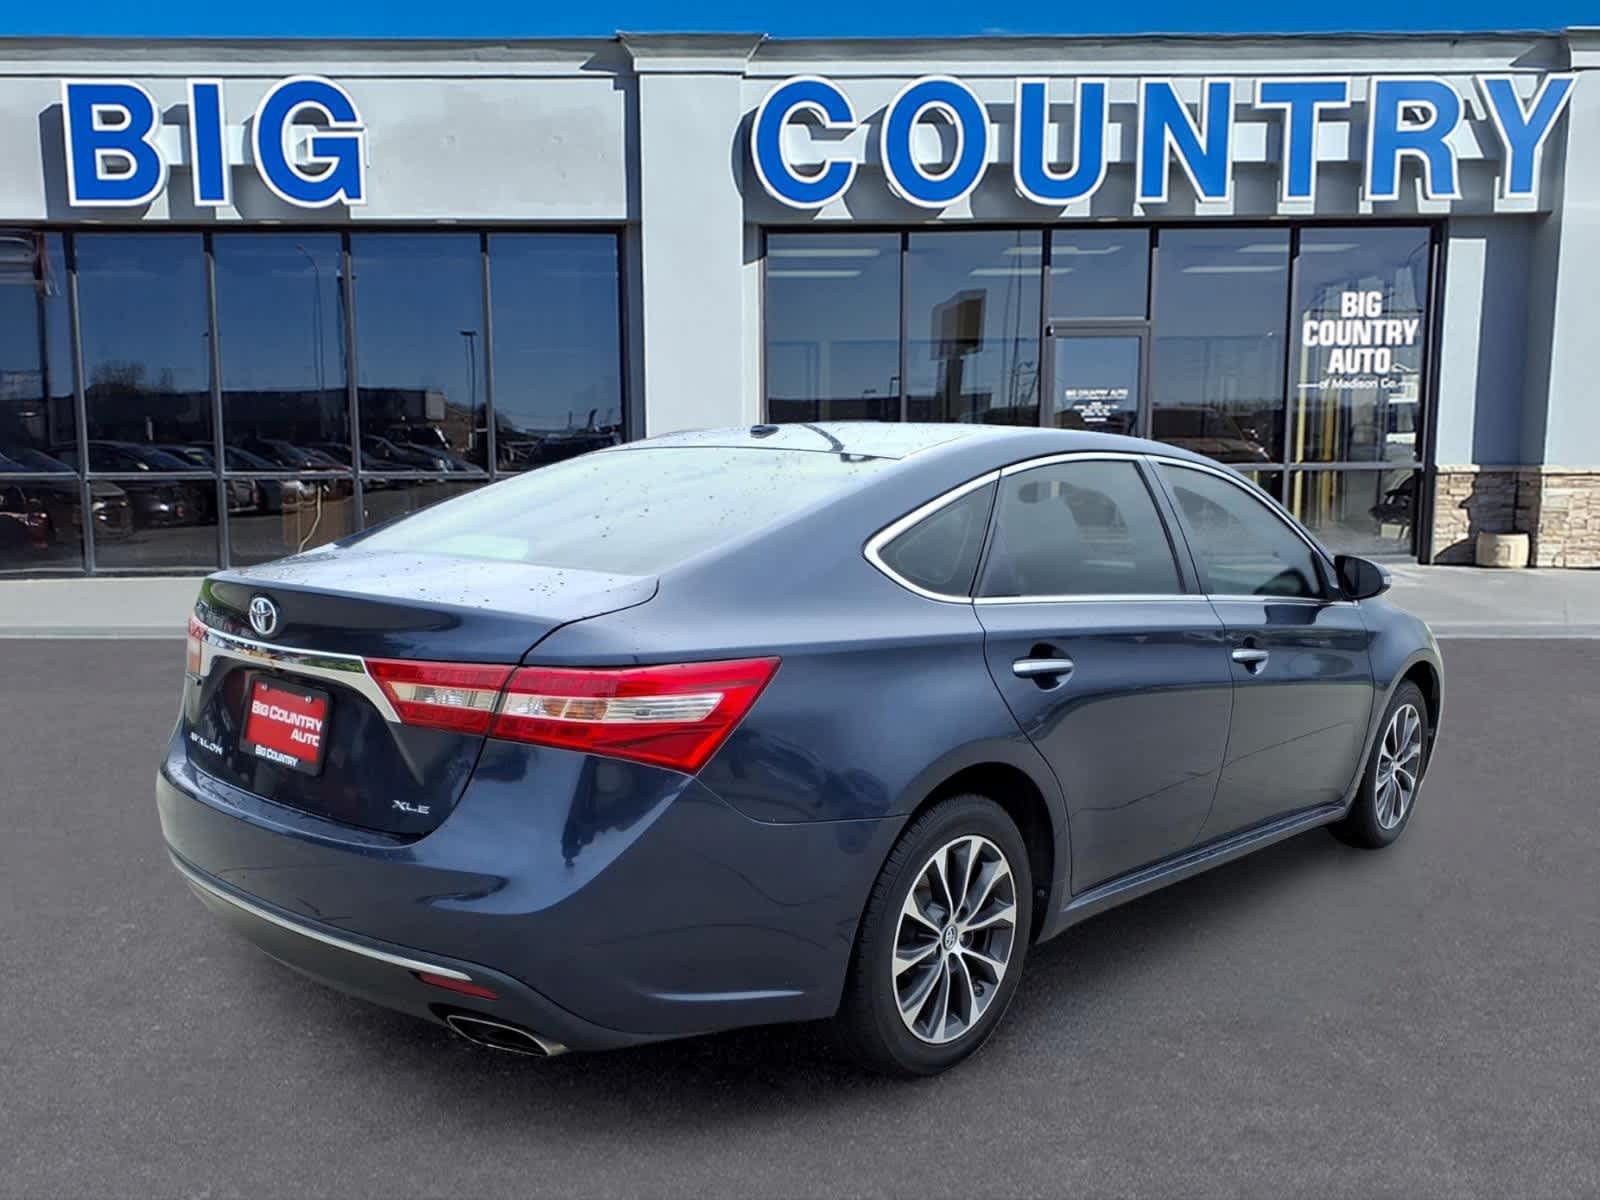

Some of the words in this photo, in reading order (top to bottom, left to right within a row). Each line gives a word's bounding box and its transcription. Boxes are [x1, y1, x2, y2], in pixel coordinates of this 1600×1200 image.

[62, 75, 368, 208] BIG
[750, 73, 1577, 208] COUNTRY
[1341, 291, 1383, 318] BIG
[1302, 318, 1420, 347] COUNTRY
[1327, 348, 1391, 374] AUTO
[251, 700, 269, 716] BIG
[269, 706, 323, 732] COUNTRY
[255, 744, 266, 757] BIG
[266, 748, 299, 768] COUNTRY
[392, 799, 431, 815] XLE
